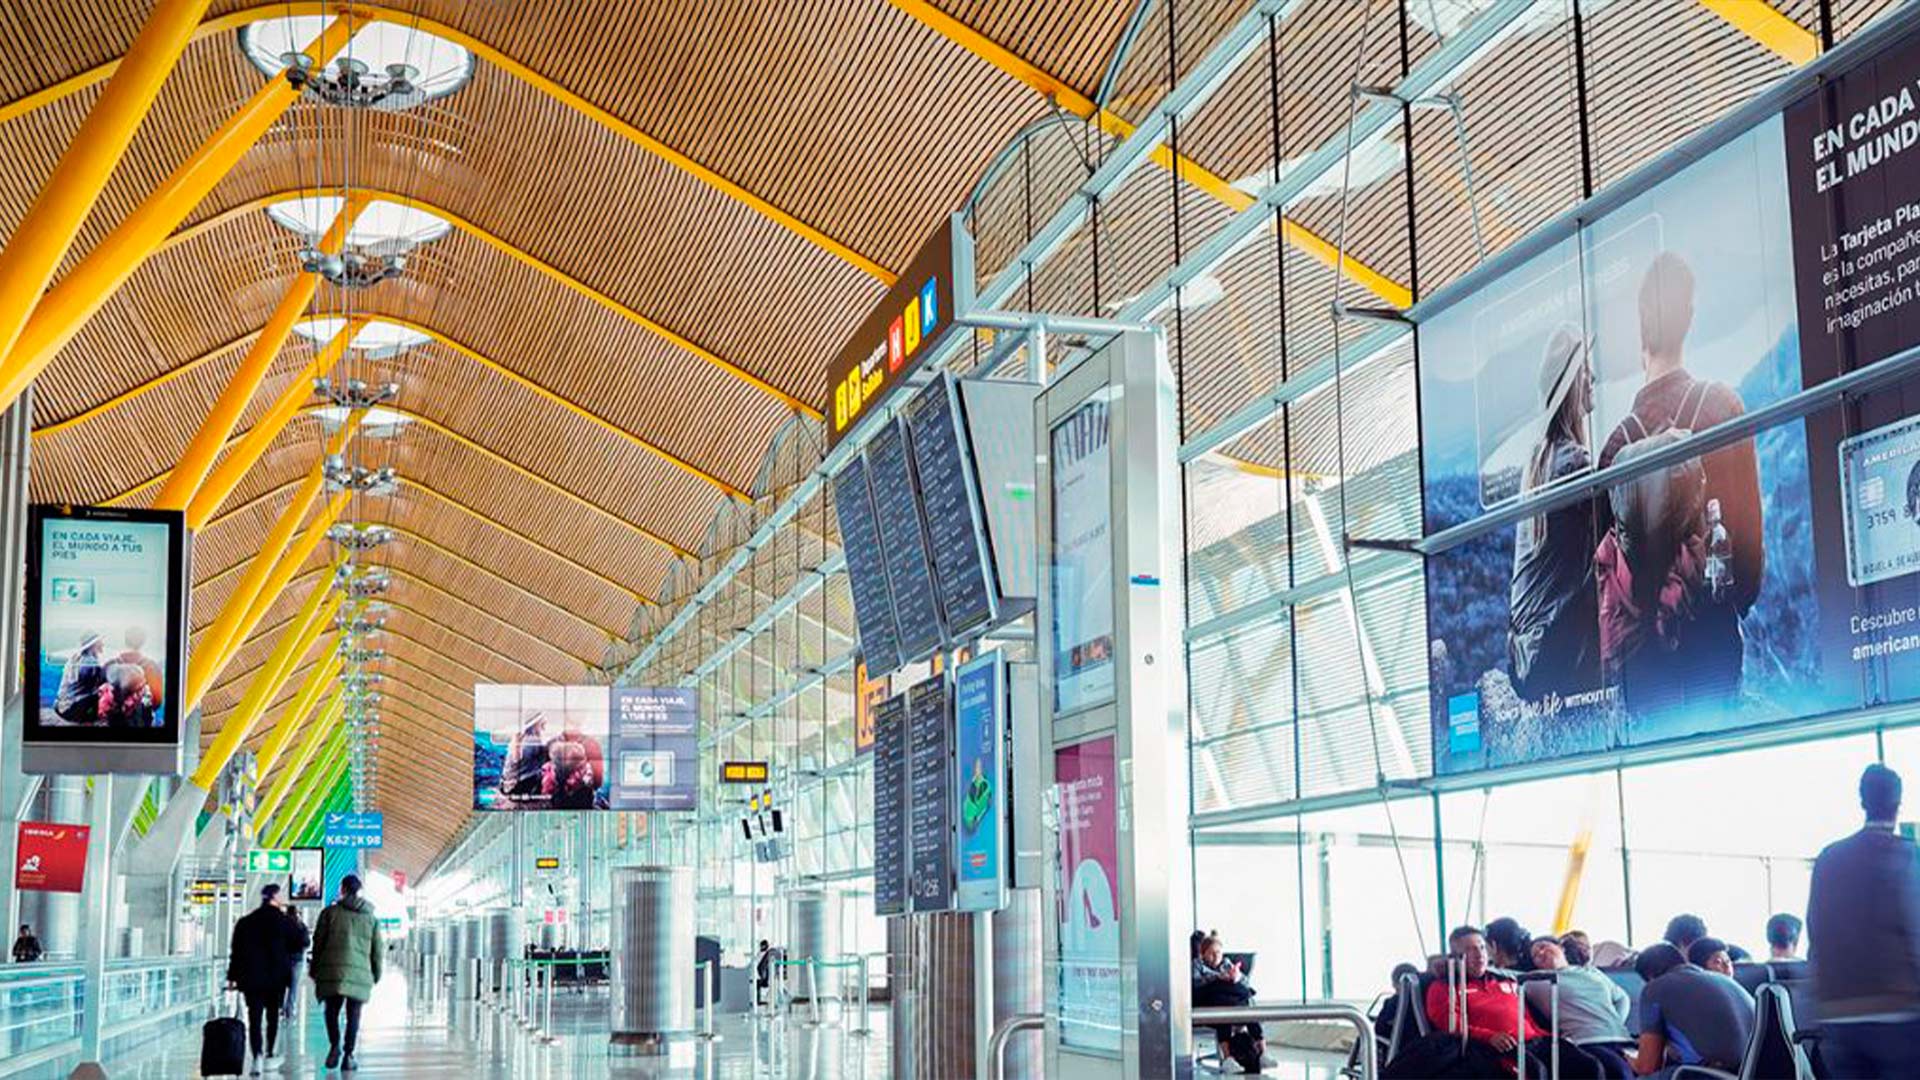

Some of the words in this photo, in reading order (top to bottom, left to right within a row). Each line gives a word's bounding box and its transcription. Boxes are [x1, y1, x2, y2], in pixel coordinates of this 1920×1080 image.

[1813, 123, 1845, 161] EN
[1849, 87, 1915, 140] CADA
[1816, 161, 1843, 193] EL
[1846, 117, 1920, 177] MUND
[1821, 243, 1838, 261] La
[1840, 217, 1892, 251] Tarjeta
[1823, 268, 1839, 285] es
[1841, 261, 1854, 277] la
[1825, 270, 1895, 310] necesitas,
[924, 289, 934, 327] K
[1826, 286, 1912, 333] imaginación
[1867, 508, 1896, 529] 3759
[52, 541, 65, 550] EL
[68, 541, 109, 552] MUNDO
[111, 543, 119, 552] A
[121, 543, 143, 553] TUS
[70, 531, 100, 540] CADA
[52, 550, 77, 560] PIES
[1851, 607, 1916, 634] Descubre
[1564, 689, 1604, 708] WITHOUT
